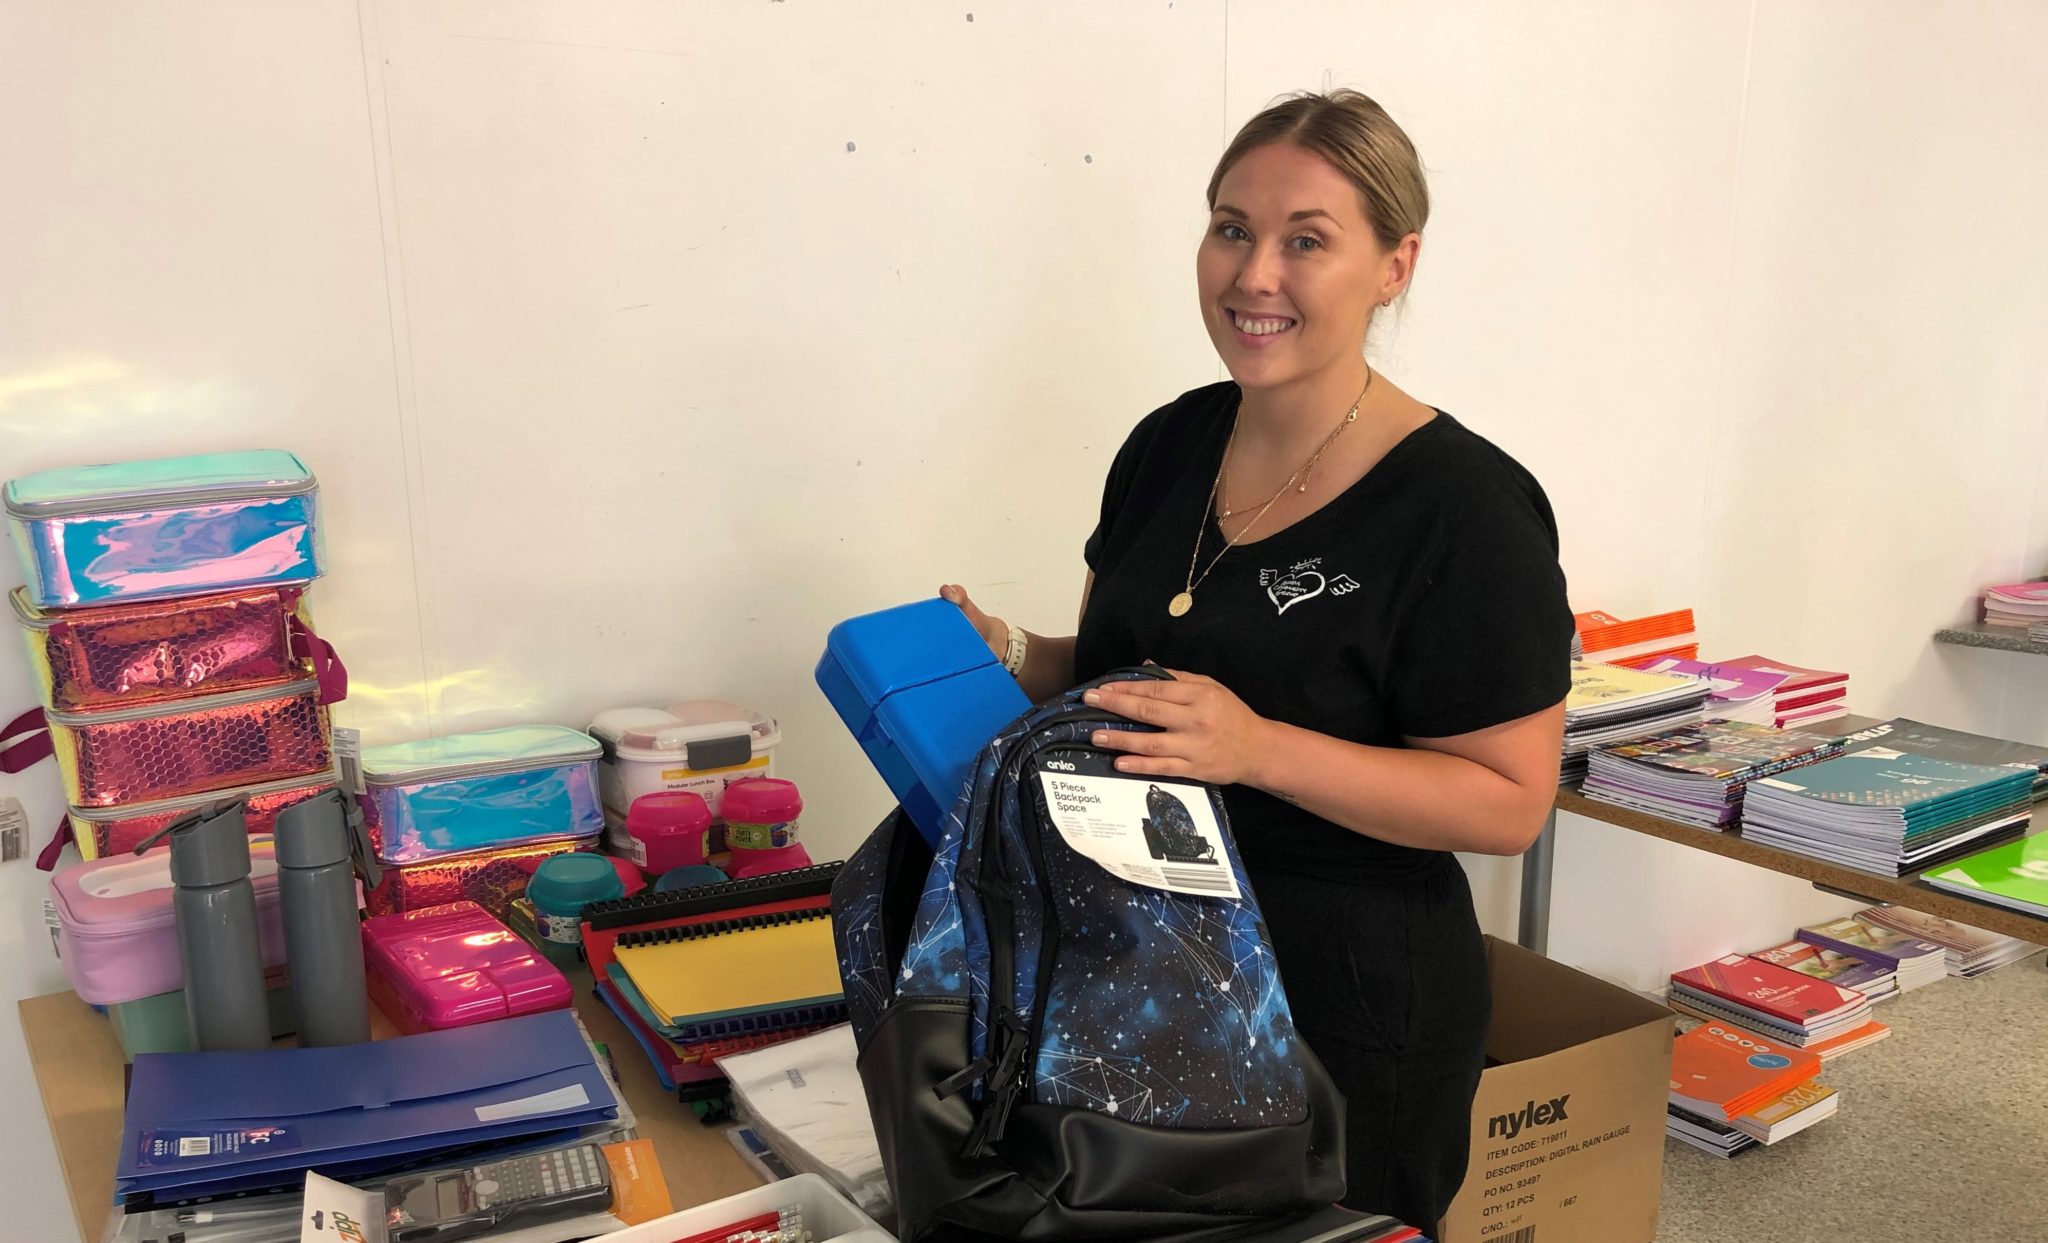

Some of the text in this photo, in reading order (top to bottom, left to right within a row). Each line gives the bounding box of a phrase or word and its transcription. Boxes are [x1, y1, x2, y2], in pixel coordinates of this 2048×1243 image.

[1047, 760, 1075, 772] anko
[667, 782, 688, 790] Modular
[1052, 781, 1086, 793] 5 Piece
[1054, 791, 1101, 804] Backpack
[1057, 802, 1087, 814] Space
[1748, 987, 1777, 999] 240
[1488, 1094, 1570, 1139] nylex
[1485, 1125, 1631, 1180] DESCRIPTION: DIGITAL RAIN GAUGE
[1487, 1130, 1568, 1161] ITEM CODE: 719011
[1484, 1174, 1541, 1199] PO NO. 93497
[1482, 1204, 1504, 1217] QTY:
[1505, 1199, 1516, 1211] 12
[1517, 1194, 1535, 1207] PCS
[1481, 1221, 1508, 1236] C/NO.:
